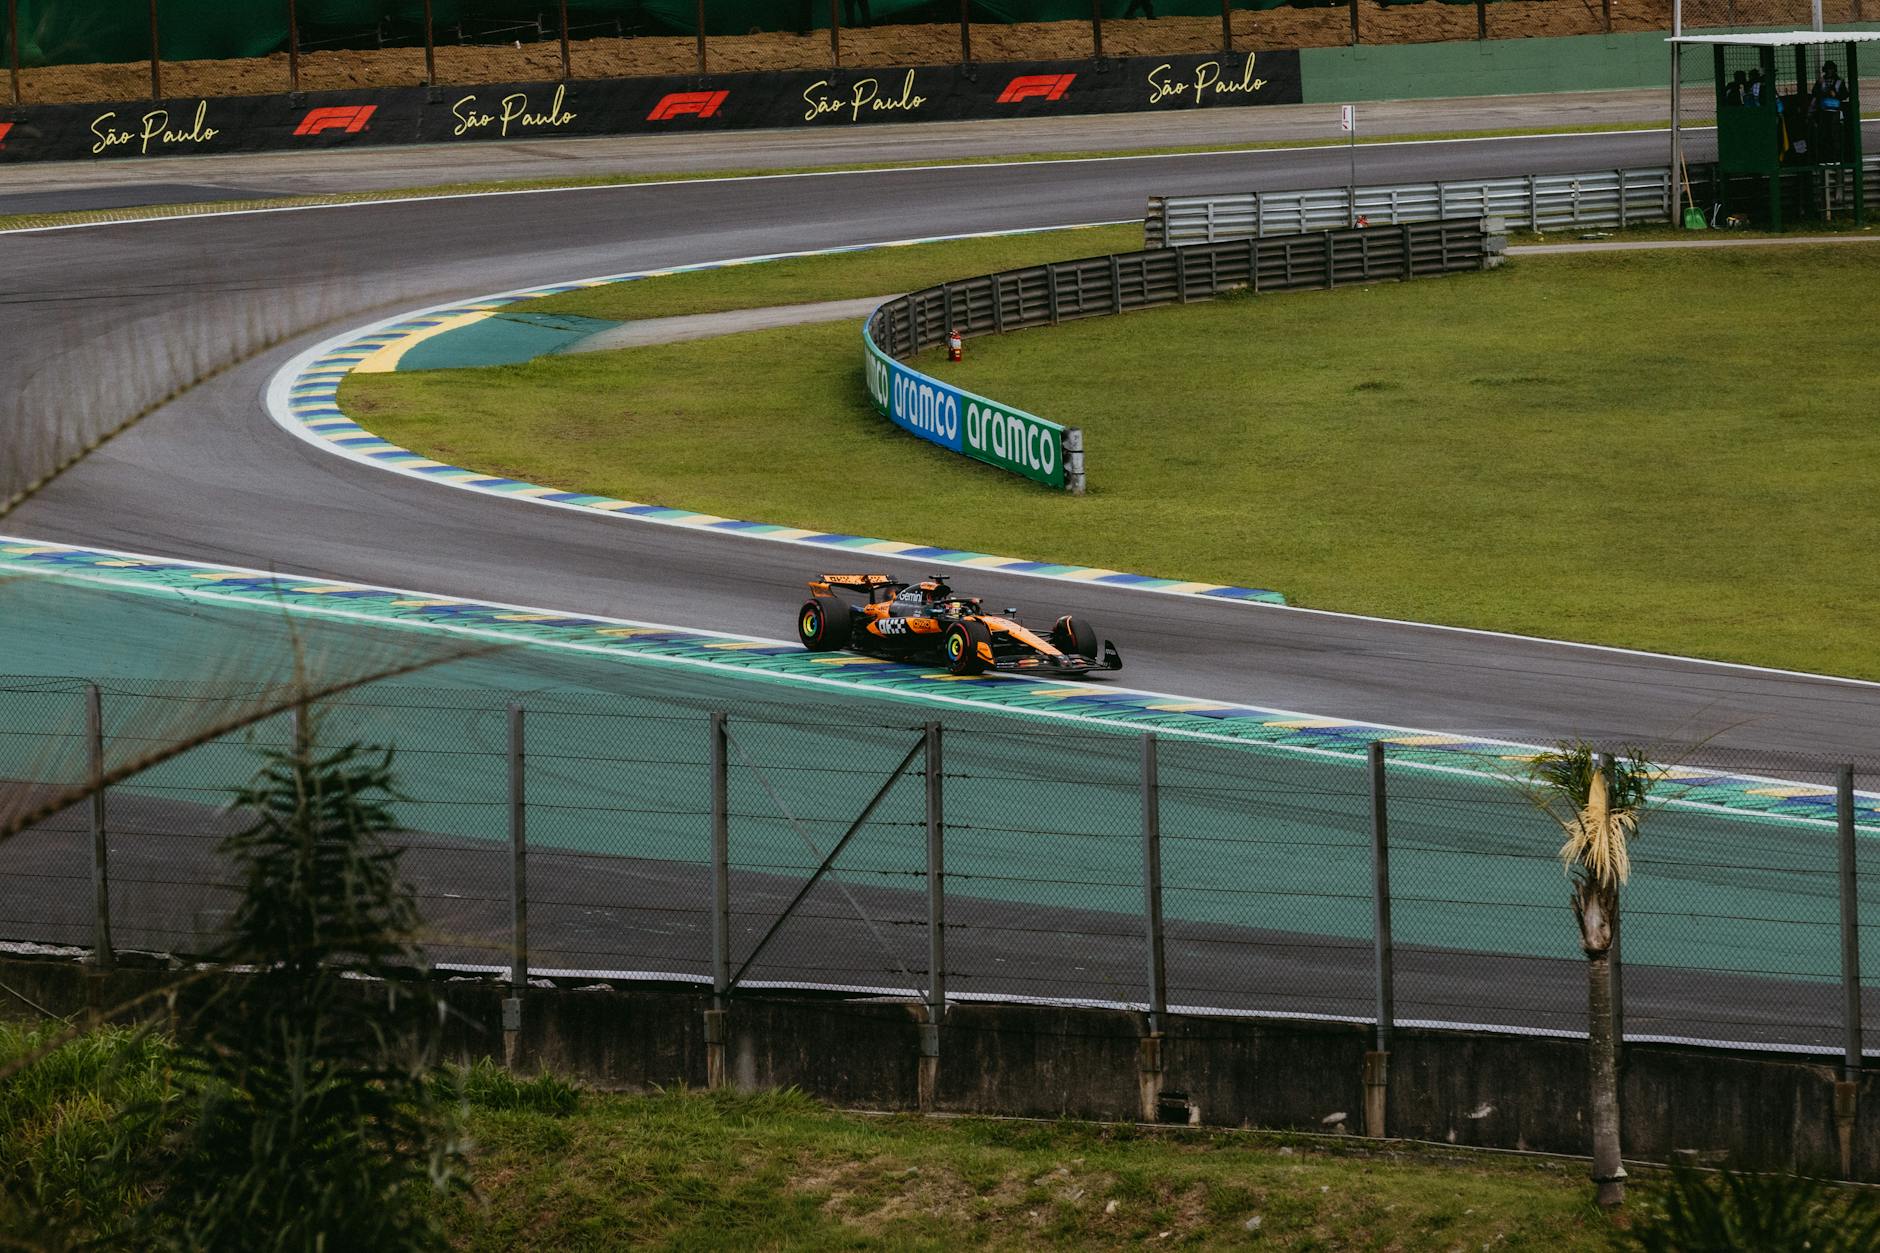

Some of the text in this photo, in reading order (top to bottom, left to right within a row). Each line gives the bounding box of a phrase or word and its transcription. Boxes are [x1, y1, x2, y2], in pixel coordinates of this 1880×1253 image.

[804, 68, 925, 121] São Paulo
[1148, 51, 1267, 104] São Paulo
[91, 100, 219, 154] São Paulo
[453, 84, 577, 136] São Paulo
[894, 372, 957, 441] aramco
[967, 402, 1055, 475] aramco
[899, 590, 923, 602] Gemini
